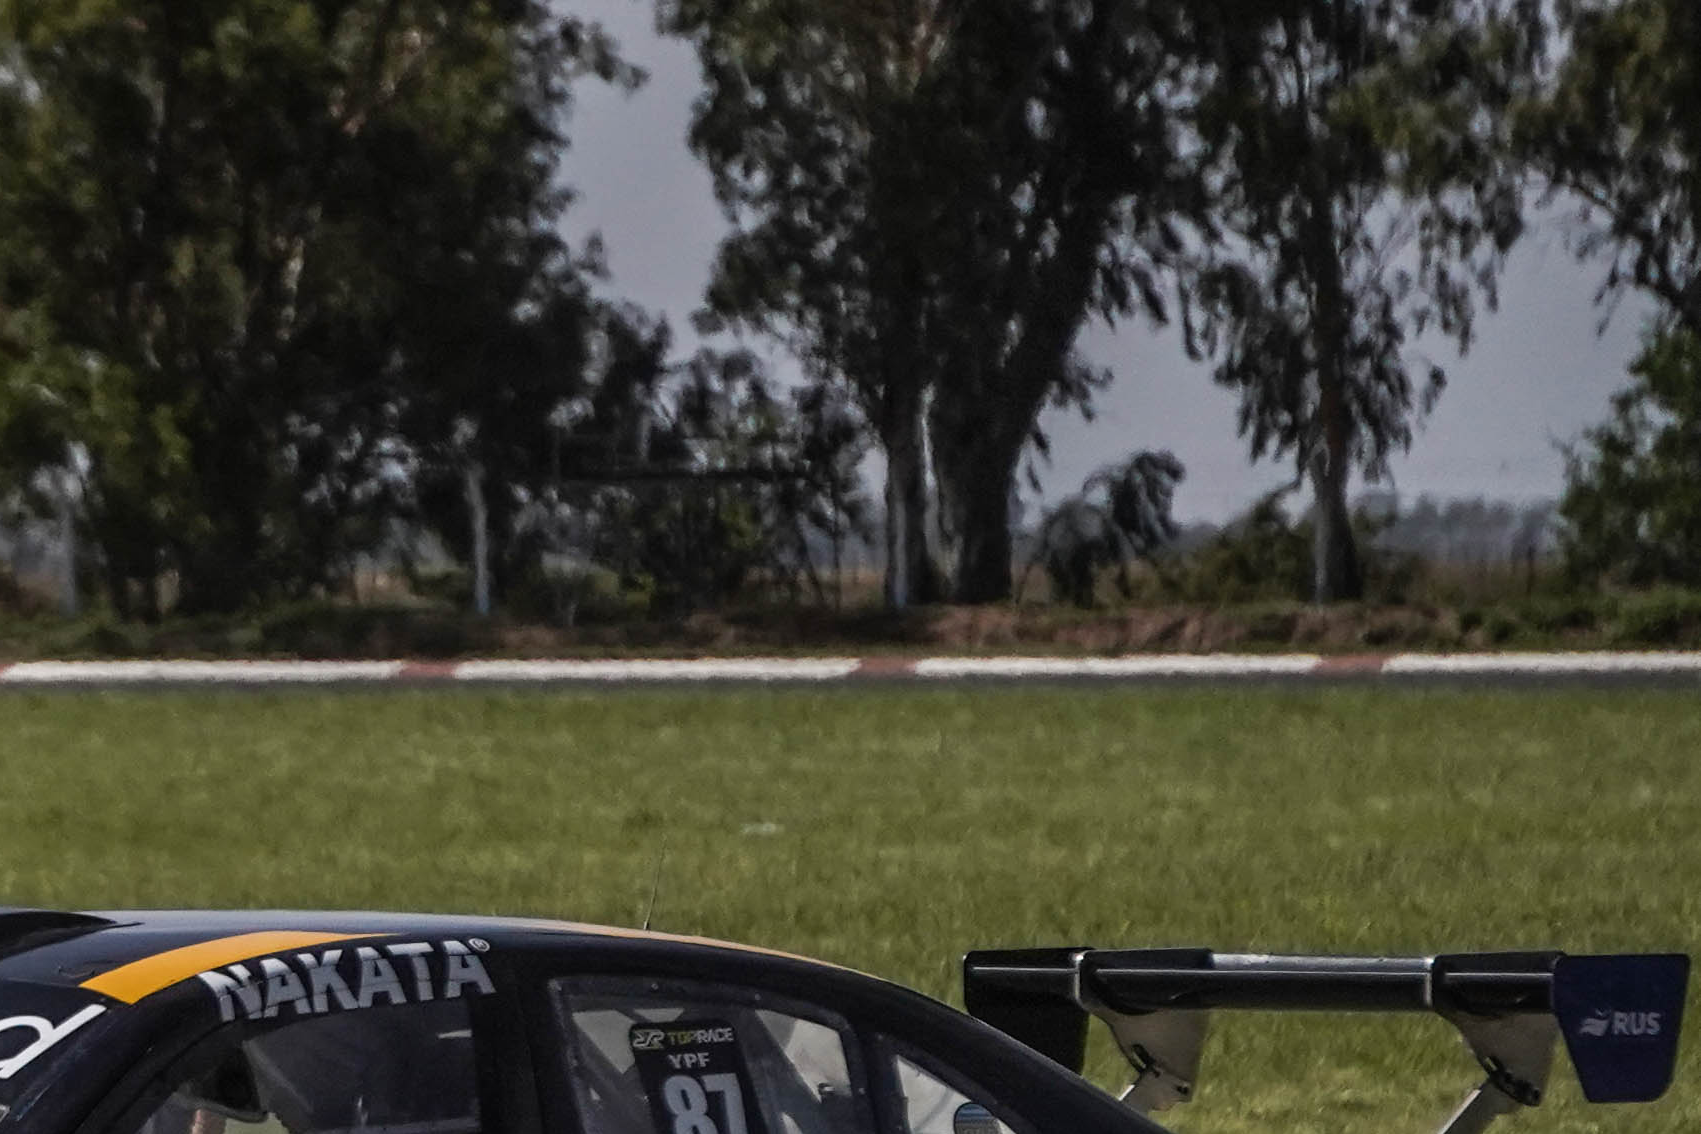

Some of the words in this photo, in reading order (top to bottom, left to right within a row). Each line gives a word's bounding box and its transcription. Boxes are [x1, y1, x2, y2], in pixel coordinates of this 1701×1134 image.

[199, 940, 497, 1022] NAKATA
[1612, 1011, 1662, 1036] RUS
[667, 1052, 711, 1069] YPF
